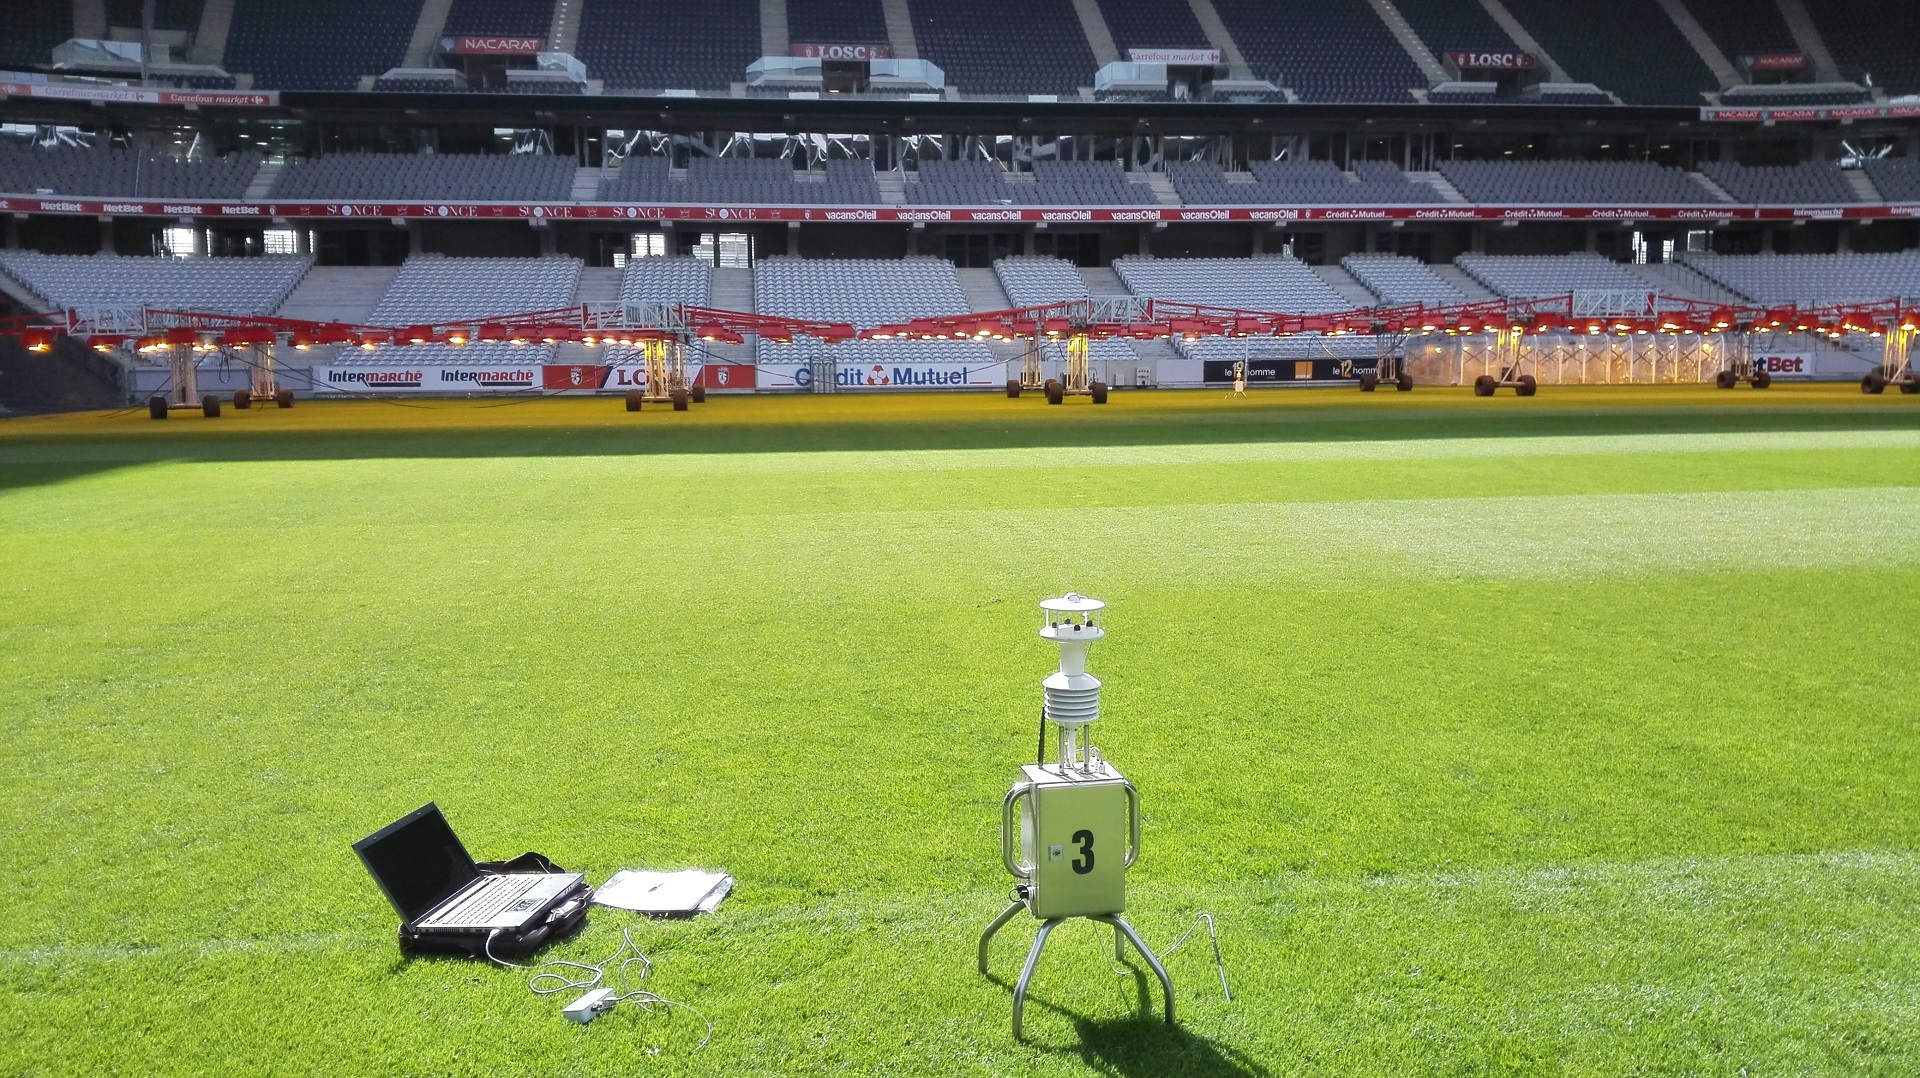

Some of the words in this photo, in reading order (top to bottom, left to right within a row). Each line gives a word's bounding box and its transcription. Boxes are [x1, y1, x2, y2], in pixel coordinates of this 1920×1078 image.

[465, 39, 538, 49] NACARAT
[818, 46, 866, 59] LOSC
[1130, 52, 1170, 61] Carrefour
[1172, 53, 1204, 61] market
[1469, 54, 1513, 66] LOSC
[1760, 56, 1803, 65] NACARAT
[45, 88, 91, 98] Carrefour
[93, 91, 128, 100] market
[171, 94, 213, 103] Carrefour
[1773, 110, 1816, 118] NACARAT
[41, 202, 82, 211] NetBet
[103, 204, 143, 213] NetBet
[164, 205, 202, 214] NetBet
[221, 206, 259, 214] NetBet
[1326, 210, 1350, 218] Crédit
[1358, 210, 1385, 218] Mutuel
[1415, 210, 1439, 218] Crédit
[1448, 210, 1475, 218] Mutuel
[1504, 210, 1528, 218] Crédit
[1536, 210, 1563, 218] Mutuel
[1592, 210, 1615, 218] Crédit
[1623, 210, 1649, 218] Mutuel
[1678, 210, 1700, 218] Crédit
[1708, 210, 1733, 218] Mutuel
[1224, 368, 1232, 377] le
[1332, 367, 1340, 375] le
[1340, 360, 1352, 378] 12
[795, 368, 864, 386] Cdit
[893, 367, 968, 385] Mutuel
[1072, 829, 1095, 875] 3
